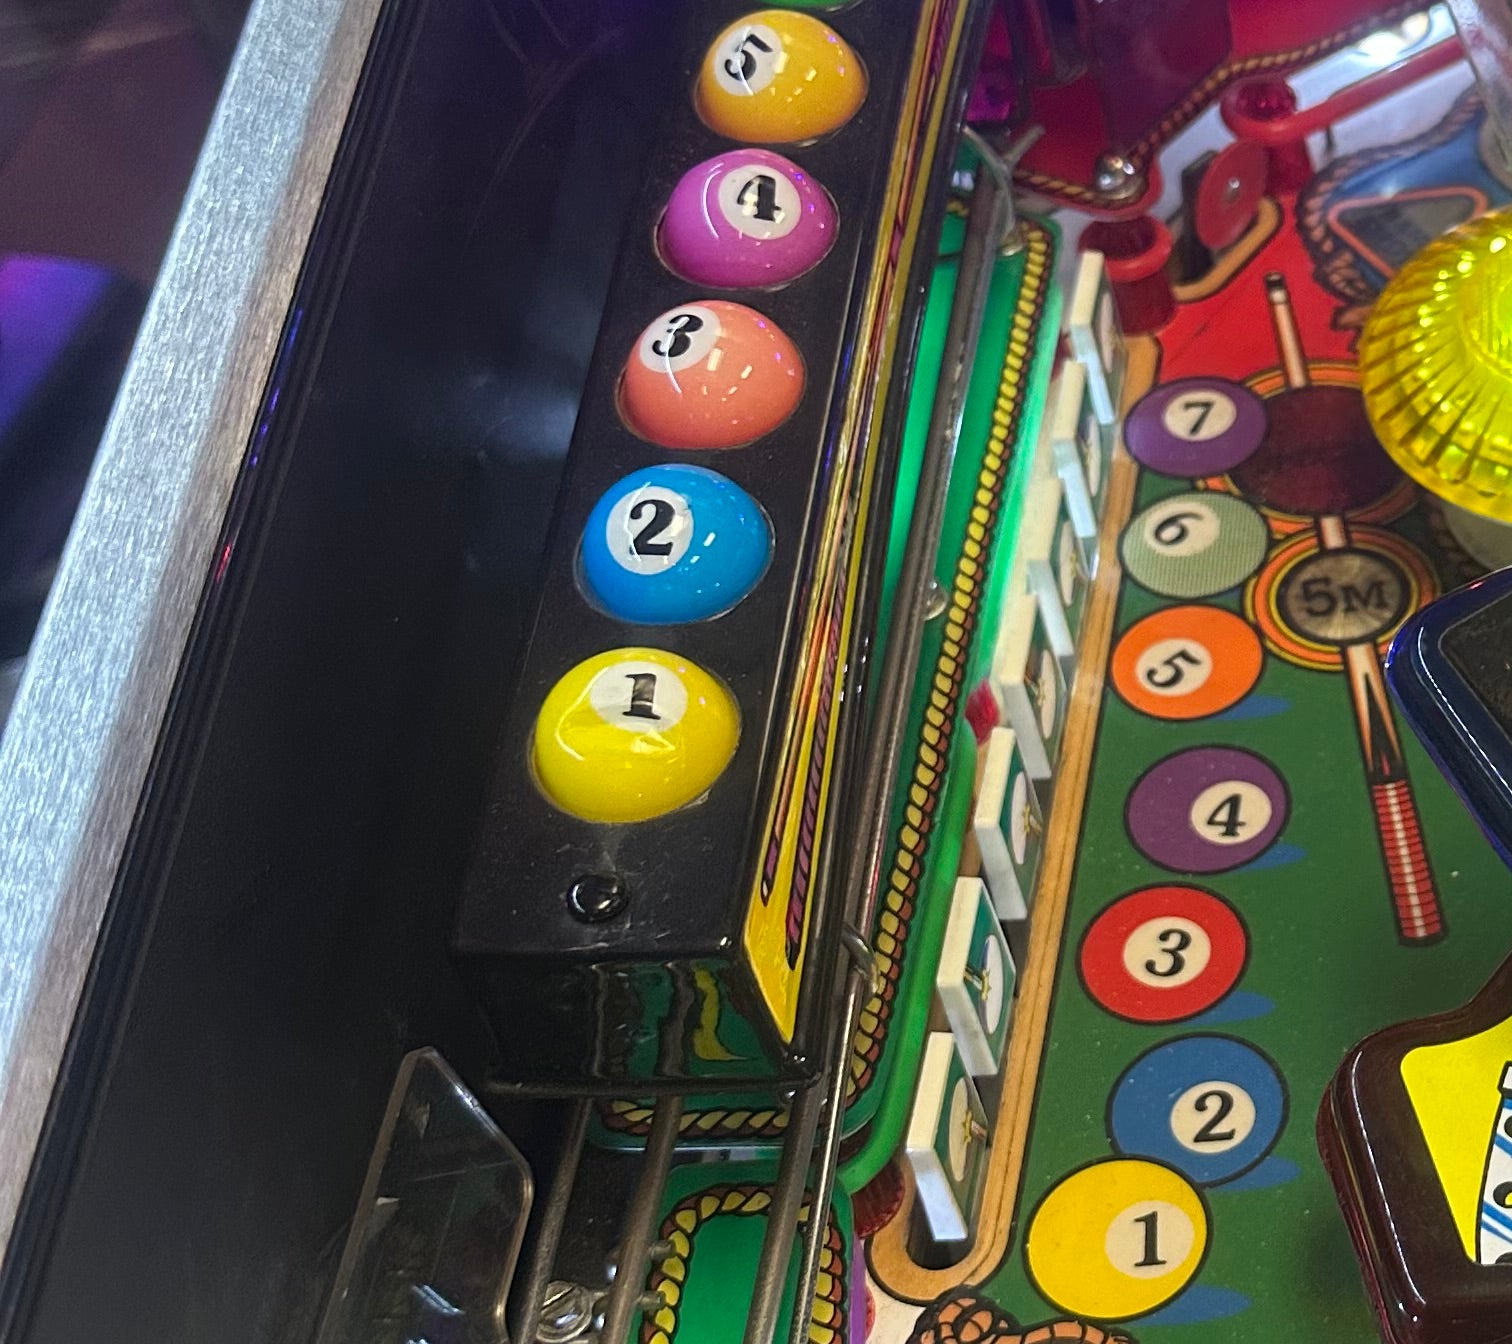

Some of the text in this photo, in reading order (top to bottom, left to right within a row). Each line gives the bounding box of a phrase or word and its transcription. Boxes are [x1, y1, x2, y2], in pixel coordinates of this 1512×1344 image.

[724, 33, 773, 81] 5
[737, 175, 783, 222] 4
[652, 314, 704, 357] 3
[1182, 401, 1216, 436] 7
[629, 499, 676, 557] 2
[1153, 511, 1205, 546] 6
[1301, 576, 1391, 618] 5M
[1145, 648, 1205, 690] 5
[622, 672, 661, 720] 1
[1206, 793, 1246, 837] 4
[1145, 928, 1192, 978] 3
[1193, 1090, 1236, 1143] 2
[1133, 1211, 1167, 1267] 1
